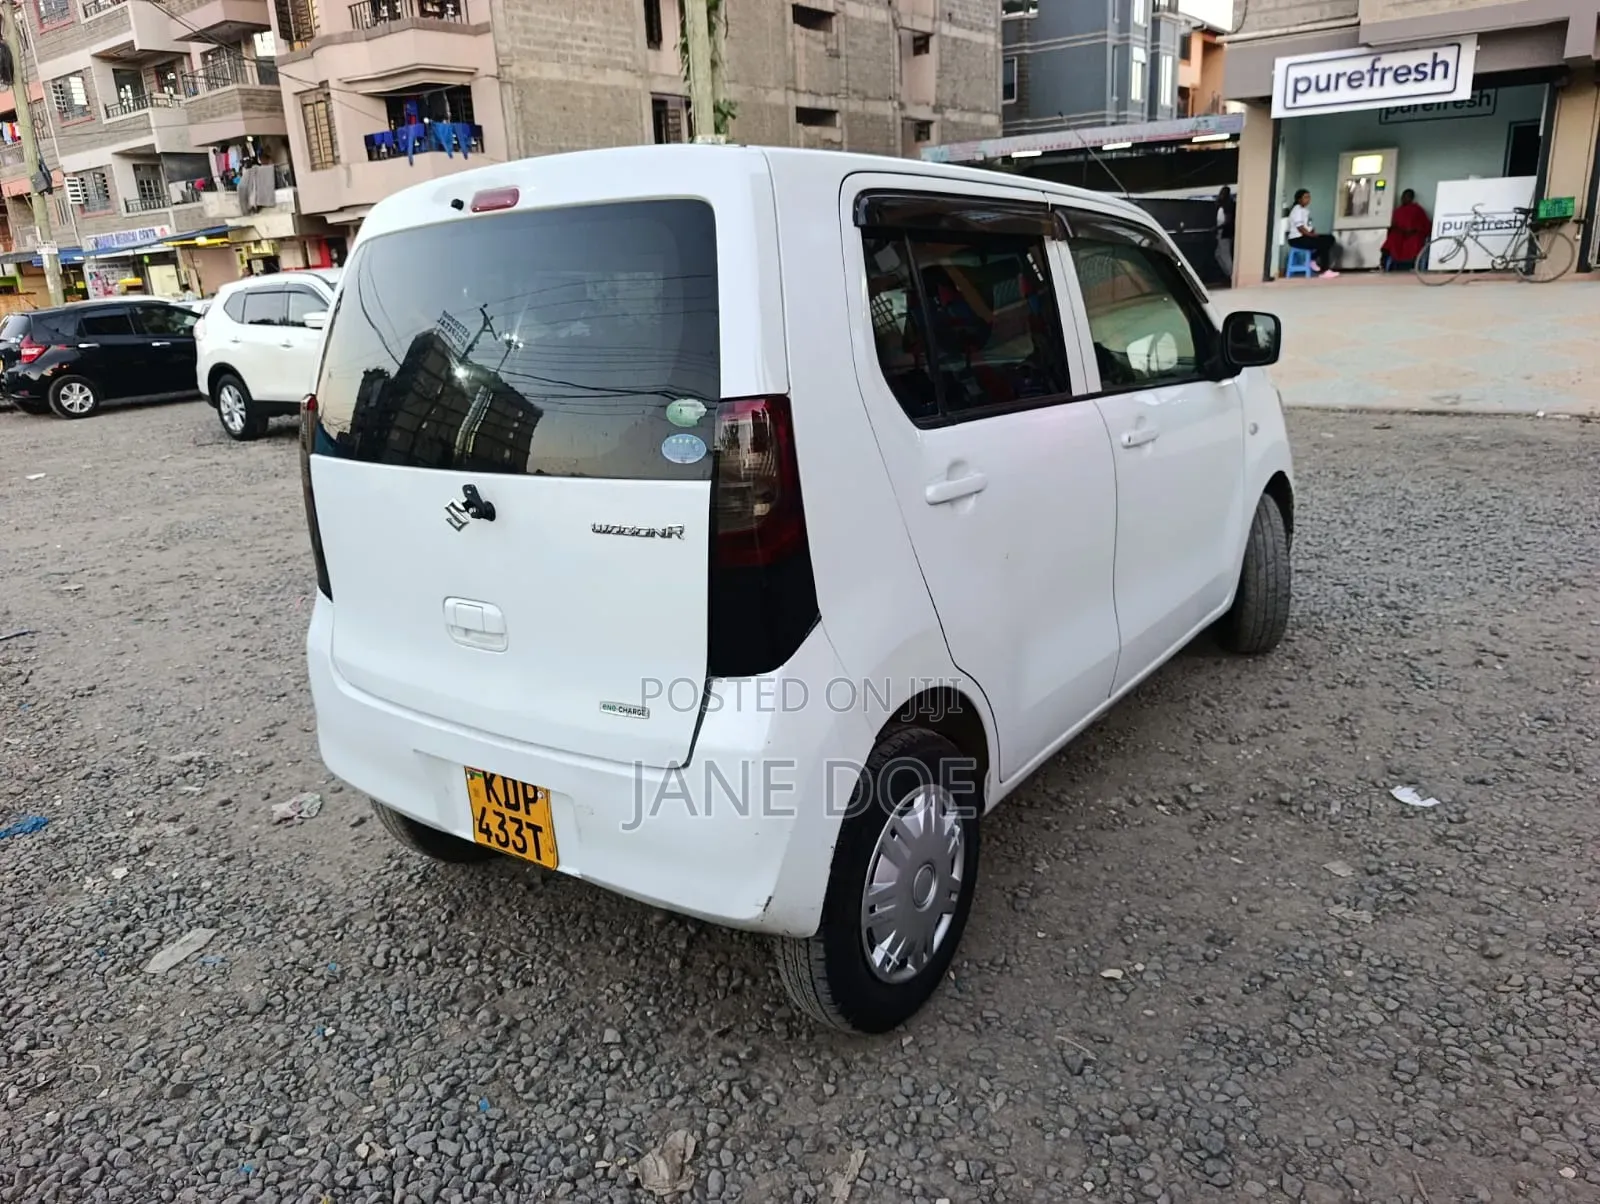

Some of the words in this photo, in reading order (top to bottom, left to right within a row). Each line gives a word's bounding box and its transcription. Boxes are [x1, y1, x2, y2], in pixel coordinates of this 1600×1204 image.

[1293, 52, 1450, 104] purefresh
[482, 770, 539, 816] KDP
[478, 806, 544, 861] 433T
